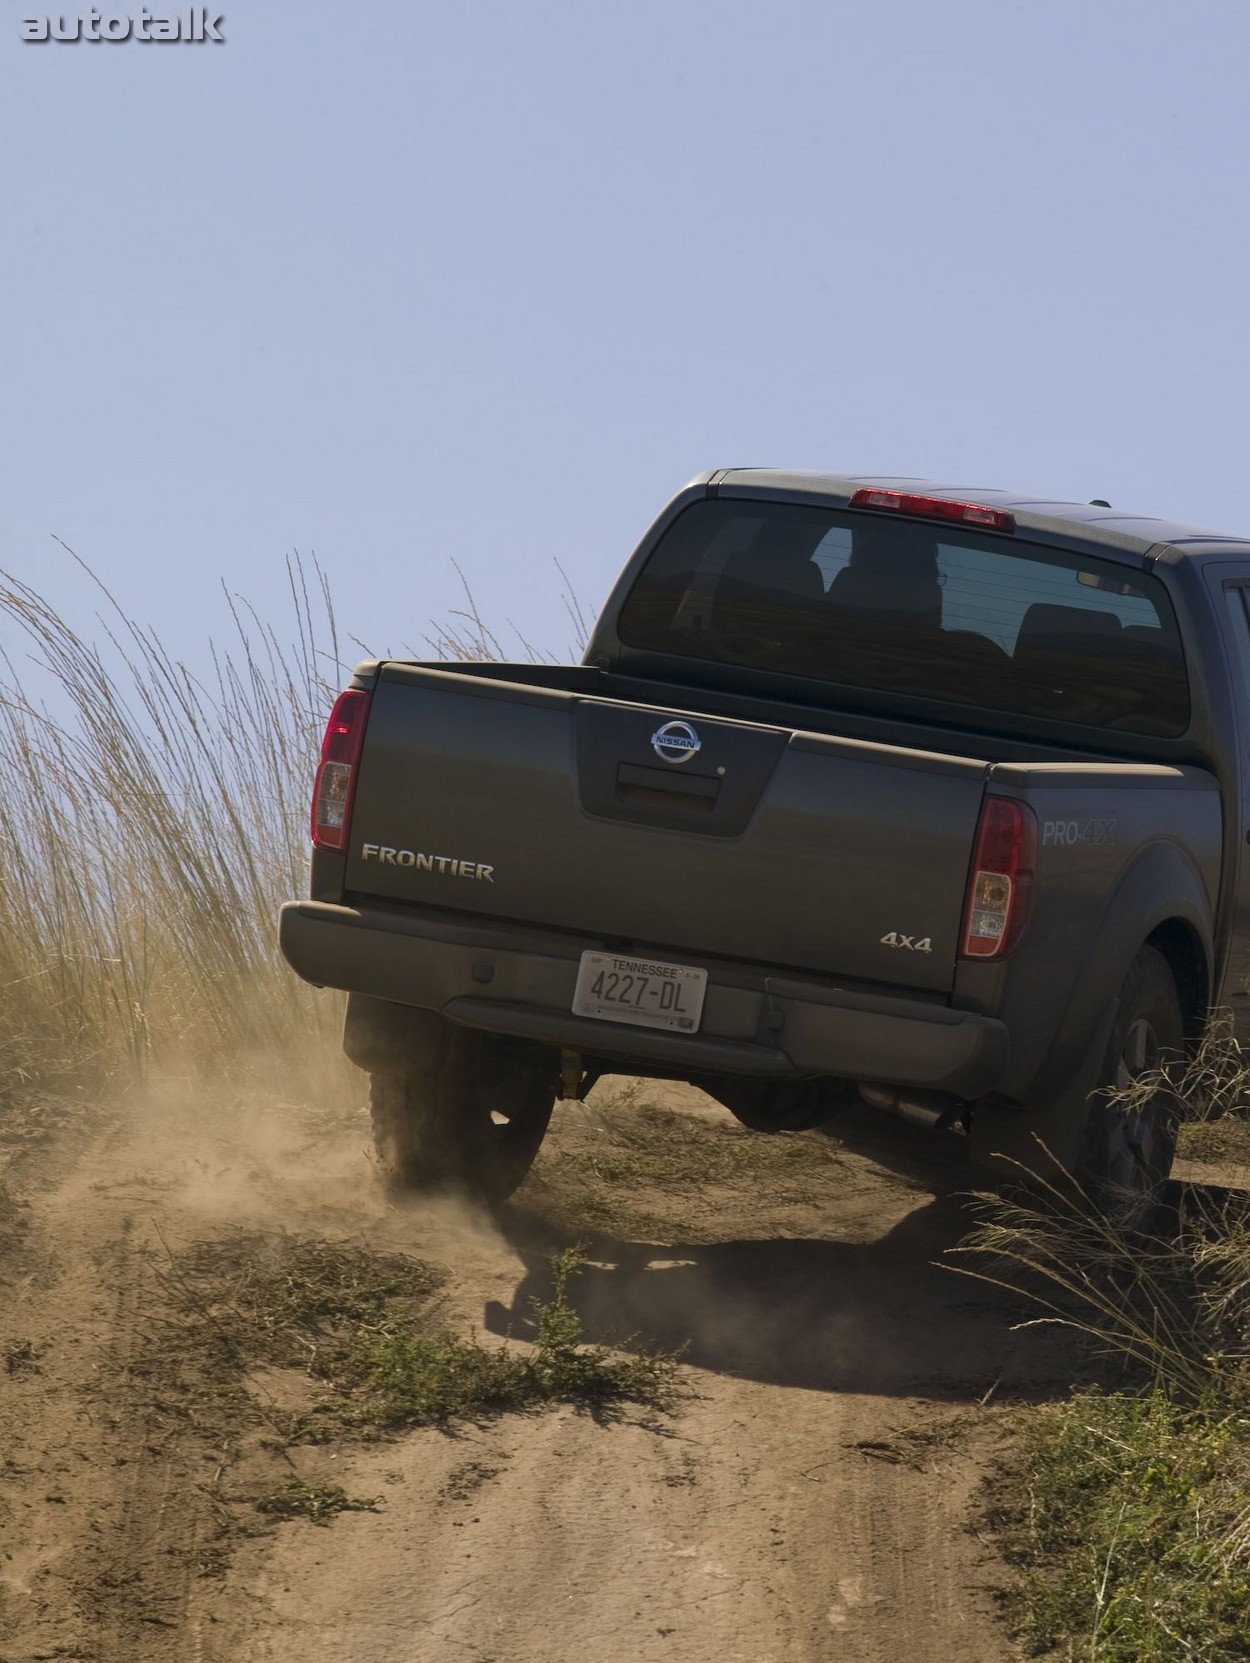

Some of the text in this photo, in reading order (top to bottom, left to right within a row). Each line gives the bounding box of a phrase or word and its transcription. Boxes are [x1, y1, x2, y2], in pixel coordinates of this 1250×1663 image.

[655, 736, 695, 749] NISSAN
[361, 843, 495, 883] FRONTIER
[612, 958, 678, 979] TENNESSEE
[590, 970, 686, 1013] 4227-DL
